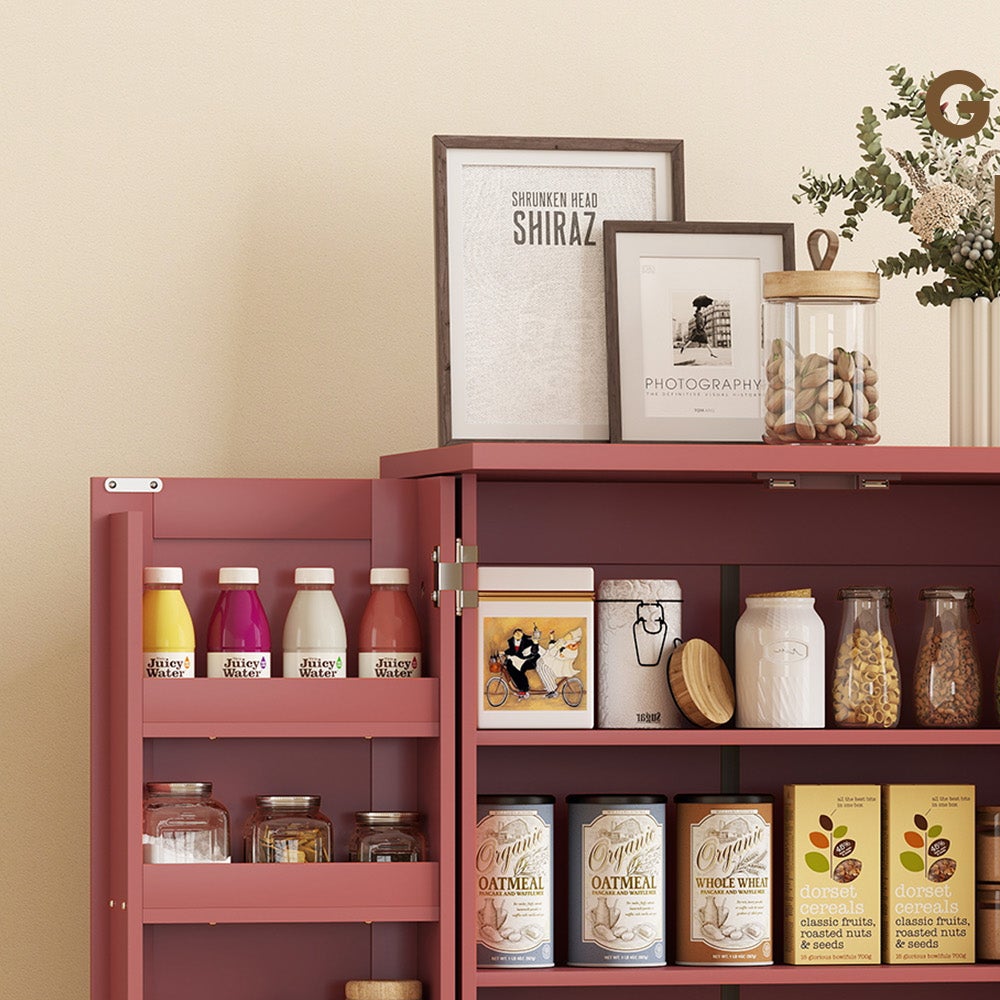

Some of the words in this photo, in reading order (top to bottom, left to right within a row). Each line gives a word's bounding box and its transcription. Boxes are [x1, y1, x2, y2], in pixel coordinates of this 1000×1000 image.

[511, 191, 566, 208] SHRUNKEN
[571, 192, 598, 208] HEAD
[512, 210, 598, 247] SHIRAZ
[645, 377, 761, 390] PHOTOGRAPHY
[148, 657, 183, 670] Juicy
[224, 657, 260, 670] Juicy
[300, 657, 336, 670] Juicy
[376, 657, 412, 670] Juicy
[146, 668, 185, 678] Water
[222, 668, 261, 678] Water
[298, 668, 338, 678] Water
[374, 668, 413, 678] Water
[476, 827, 543, 874] Organic
[588, 826, 655, 873] Organic
[696, 825, 763, 873] Organic
[478, 876, 545, 890] OATMEAL
[591, 876, 657, 890] OATMEAL
[696, 877, 736, 888] WHOLE
[738, 877, 769, 888] WHEAT
[800, 884, 858, 899] dorset
[895, 884, 952, 898] dorset
[800, 900, 865, 915] cereals
[895, 900, 959, 915] cereals
[800, 917, 839, 927] classic
[841, 917, 876, 928] fruits,
[895, 916, 933, 927] classic
[936, 916, 971, 927] fruits,
[800, 928, 843, 938] roasted
[846, 929, 872, 938] nuts
[895, 928, 938, 938] roasted
[941, 928, 967, 937] nuts
[800, 940, 811, 949] &
[813, 940, 845, 950] seeds
[895, 940, 905, 949] &
[907, 939, 939, 949] seeds
